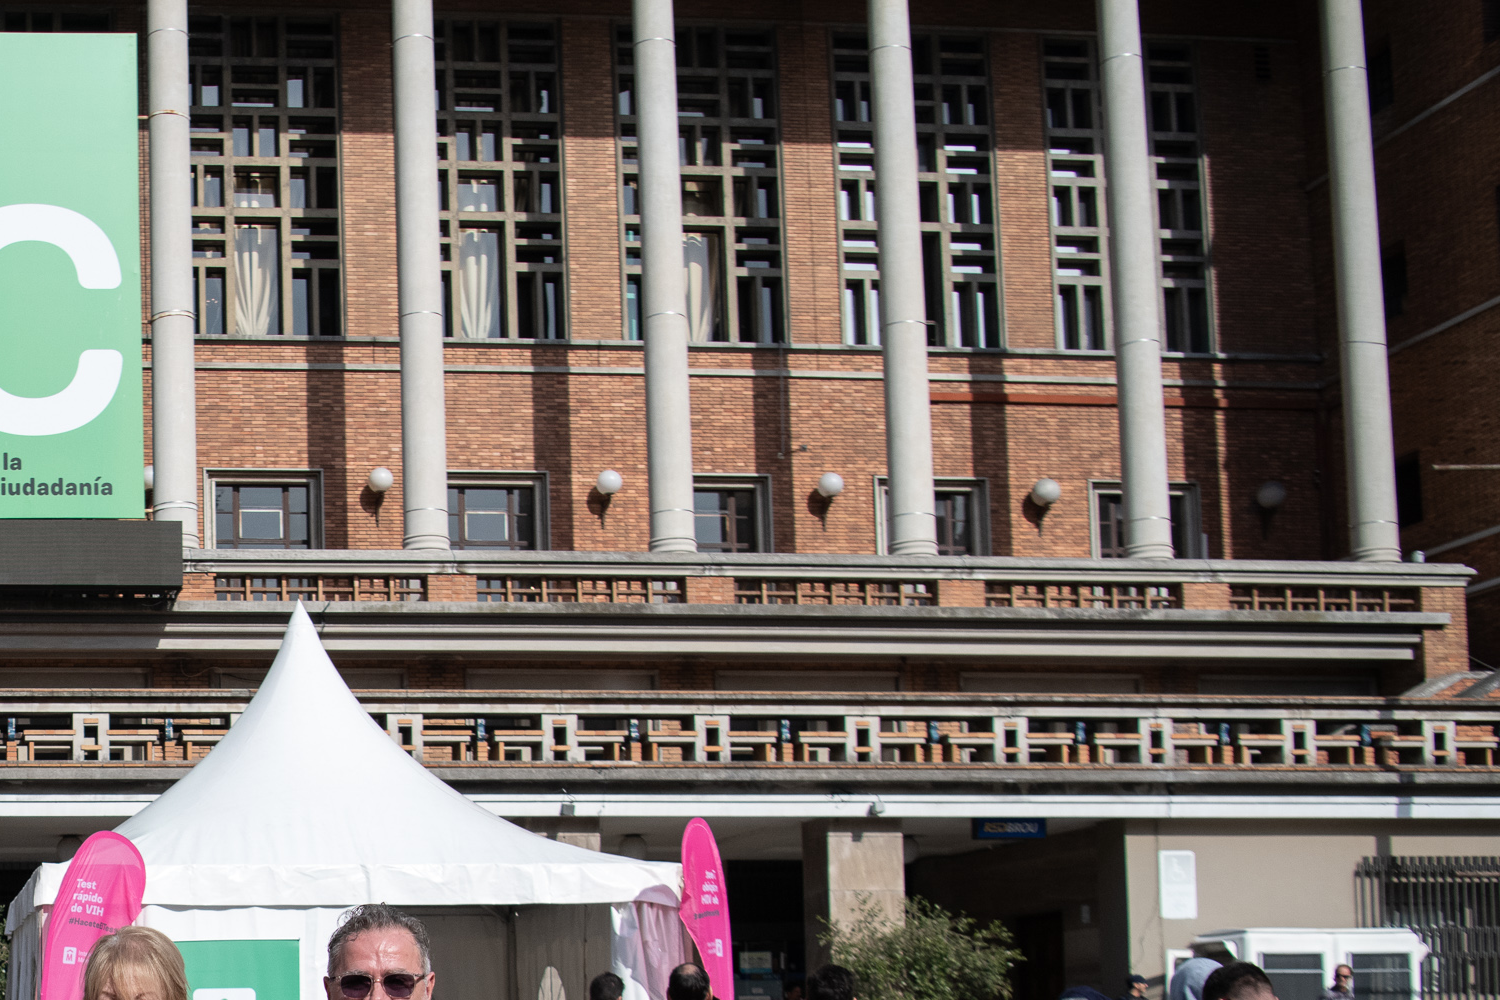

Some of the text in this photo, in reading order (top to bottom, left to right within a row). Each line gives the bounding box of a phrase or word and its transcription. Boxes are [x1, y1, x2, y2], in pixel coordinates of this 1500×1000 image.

[3, 452, 23, 471] la
[76, 878, 97, 890] Test
[72, 890, 103, 904] rápido
[70, 903, 105, 917] de VIH
